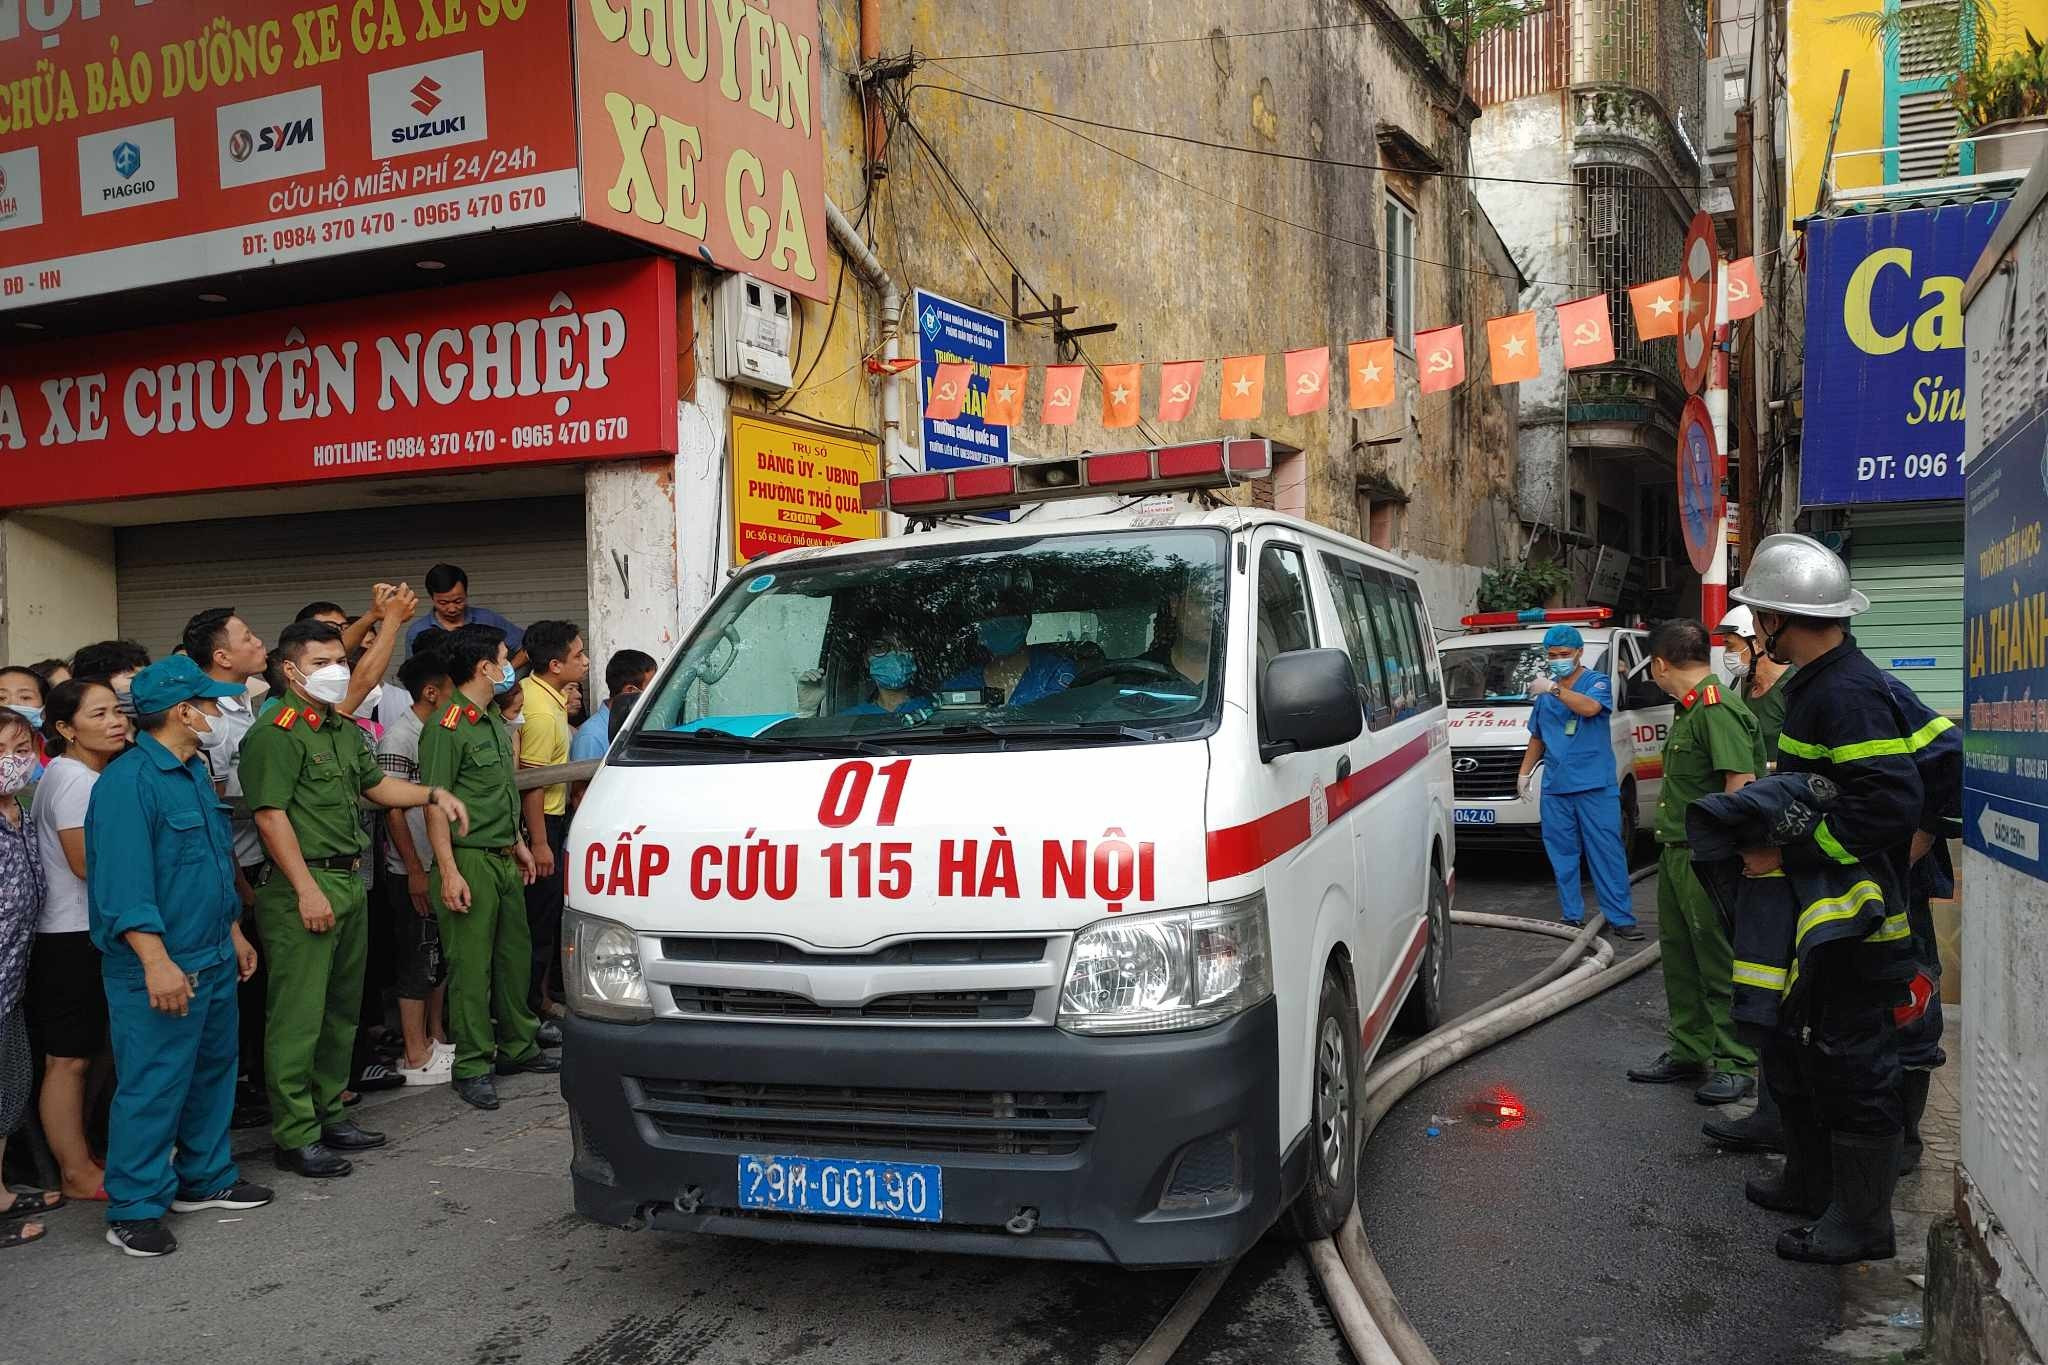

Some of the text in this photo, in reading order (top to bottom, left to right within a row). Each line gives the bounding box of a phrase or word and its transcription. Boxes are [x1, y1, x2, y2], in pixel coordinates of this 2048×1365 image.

[85, 35, 153, 115] BẢO
[161, 16, 284, 98] DƯỠNG
[292, 5, 342, 69] XE
[351, 0, 406, 54] GA
[416, 0, 467, 41] XE
[257, 117, 313, 152] SYM
[391, 116, 465, 143] SUZUKI
[103, 180, 155, 200] PIAGGIO
[269, 145, 536, 213] CỨU HỘ MIỄN PHÍ 24/24h
[604, 92, 816, 281] XE GA
[242, 233, 267, 255] ĐT:
[273, 225, 316, 250] 0984
[322, 218, 354, 242] 370
[361, 212, 395, 236] 470
[414, 200, 460, 227] 0965
[467, 193, 503, 217] 470
[509, 186, 546, 210] 670
[39, 270, 61, 291] HN
[1843, 247, 1966, 355] Ca
[39, 373, 109, 447] XE
[123, 325, 358, 437] CHUYÊN
[376, 290, 627, 416] NGHIỆP
[313, 440, 382, 467] HOTLINE:
[386, 436, 425, 461] 0984
[429, 432, 460, 456] 370
[464, 429, 495, 453] 470
[511, 426, 552, 450] 0965
[558, 421, 590, 445] 470
[595, 417, 628, 440] 670
[792, 442, 811, 457] TRỤ
[757, 450, 794, 475] ĐẢNG
[798, 456, 814, 478] ỦY
[826, 465, 859, 487] UBND
[1858, 456, 1895, 480] ĐT:
[1904, 453, 1948, 478] 096
[748, 480, 804, 505] PHƯỜNG
[808, 486, 832, 509] THỔ
[783, 510, 816, 525] 200M
[2021, 521, 2041, 568] HỌC
[1464, 711, 1494, 719] 24
[817, 759, 912, 828] 01
[584, 825, 1155, 912] CẤP CỨU 115 HÀ NỘI
